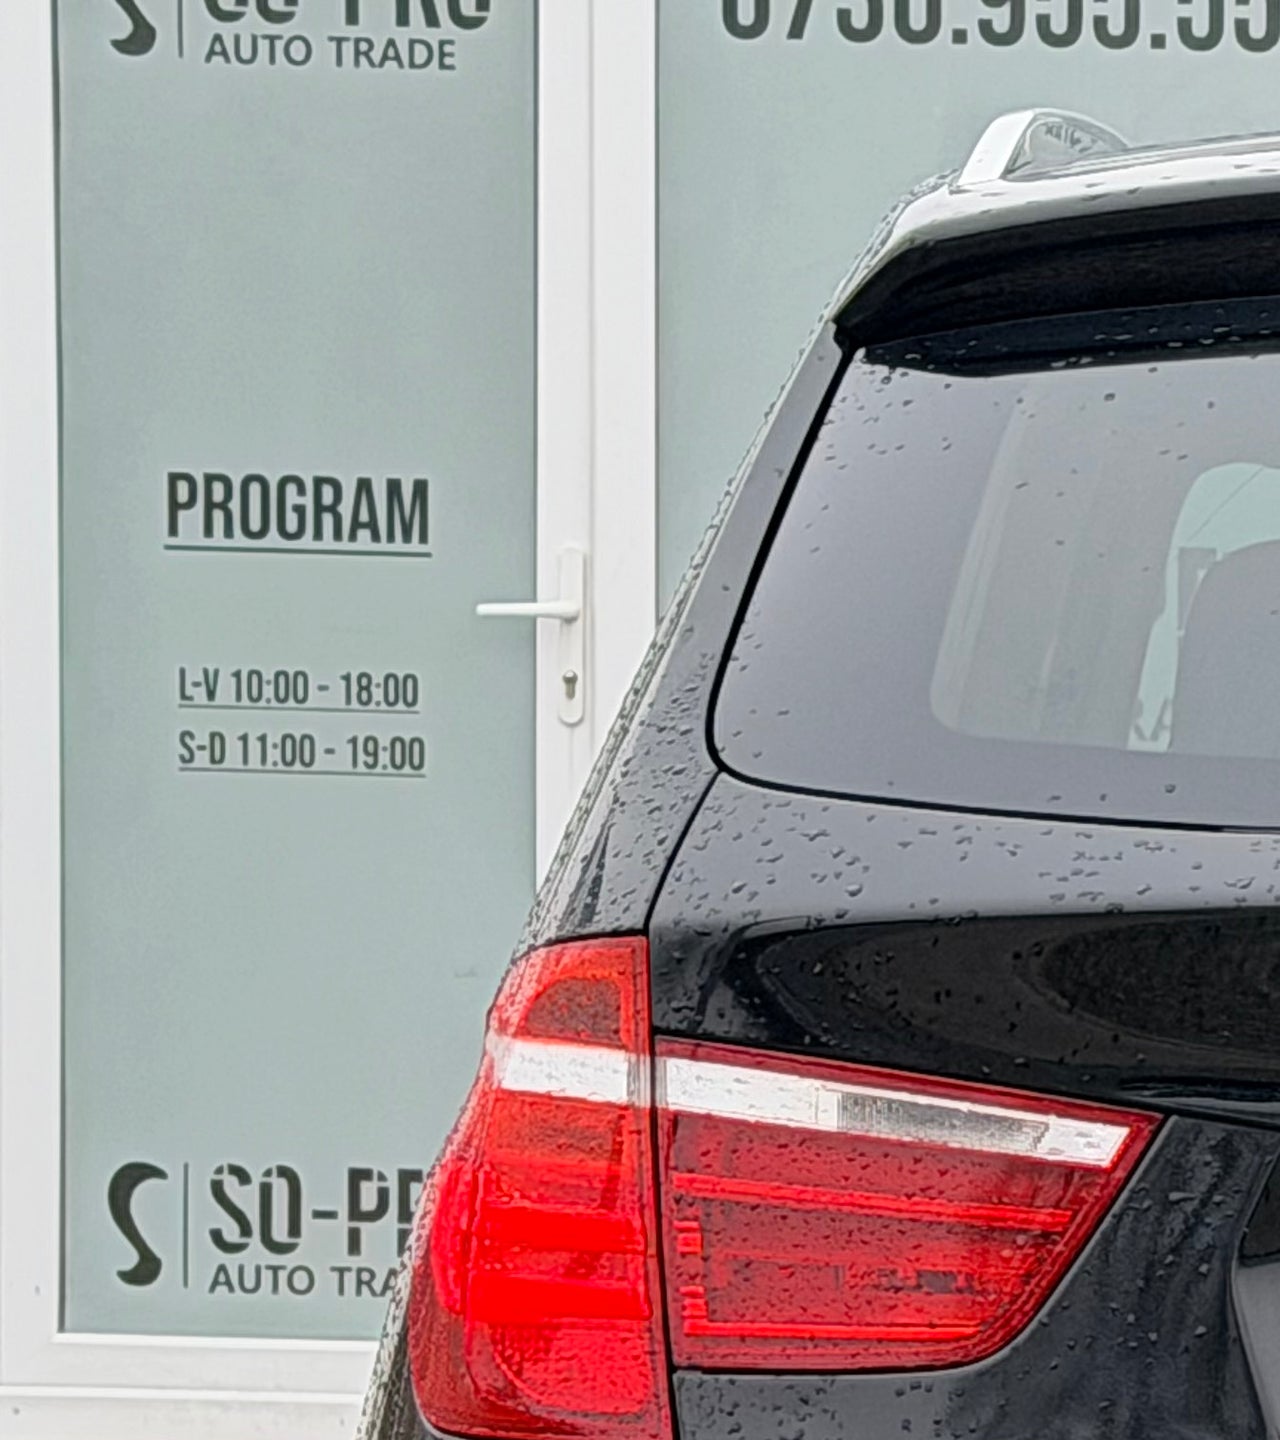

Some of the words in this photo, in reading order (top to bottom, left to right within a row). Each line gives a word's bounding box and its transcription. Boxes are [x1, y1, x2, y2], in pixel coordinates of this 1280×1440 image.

[204, 33, 313, 66] AUTO
[327, 36, 456, 70] TRADE
[166, 471, 430, 545] PROGRAM
[178, 666, 220, 701] L-V
[230, 669, 309, 704] 10:00
[340, 672, 419, 708] 18:00
[178, 730, 226, 765] S-D
[237, 732, 316, 768] 11:00
[347, 735, 425, 771] 19:00
[208, 1163, 424, 1258] SO-P
[208, 1263, 316, 1296] AUTO
[330, 1266, 399, 1298] TRA
